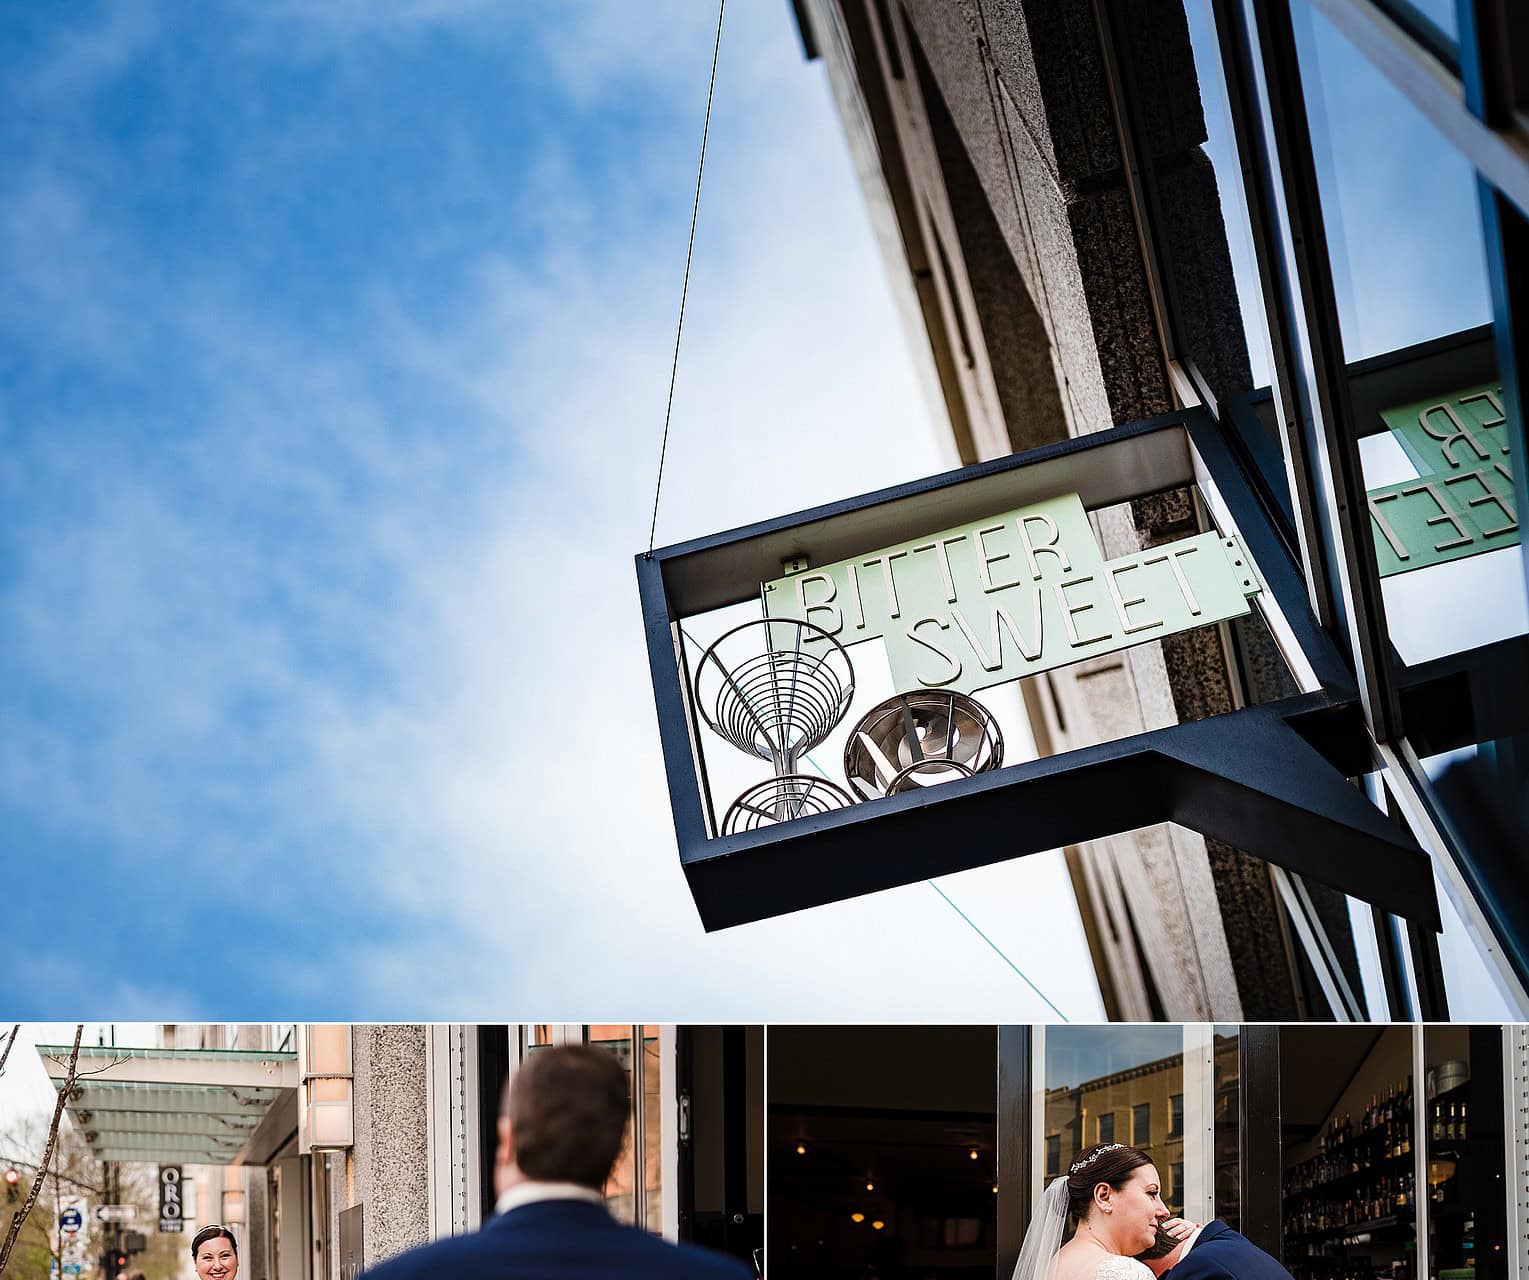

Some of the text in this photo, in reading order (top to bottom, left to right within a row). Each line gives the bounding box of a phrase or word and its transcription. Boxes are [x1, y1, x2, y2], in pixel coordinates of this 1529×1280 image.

[795, 512, 1072, 643] BITTER
[907, 546, 1200, 688] SWEET
[162, 1167, 180, 1219] ORO
